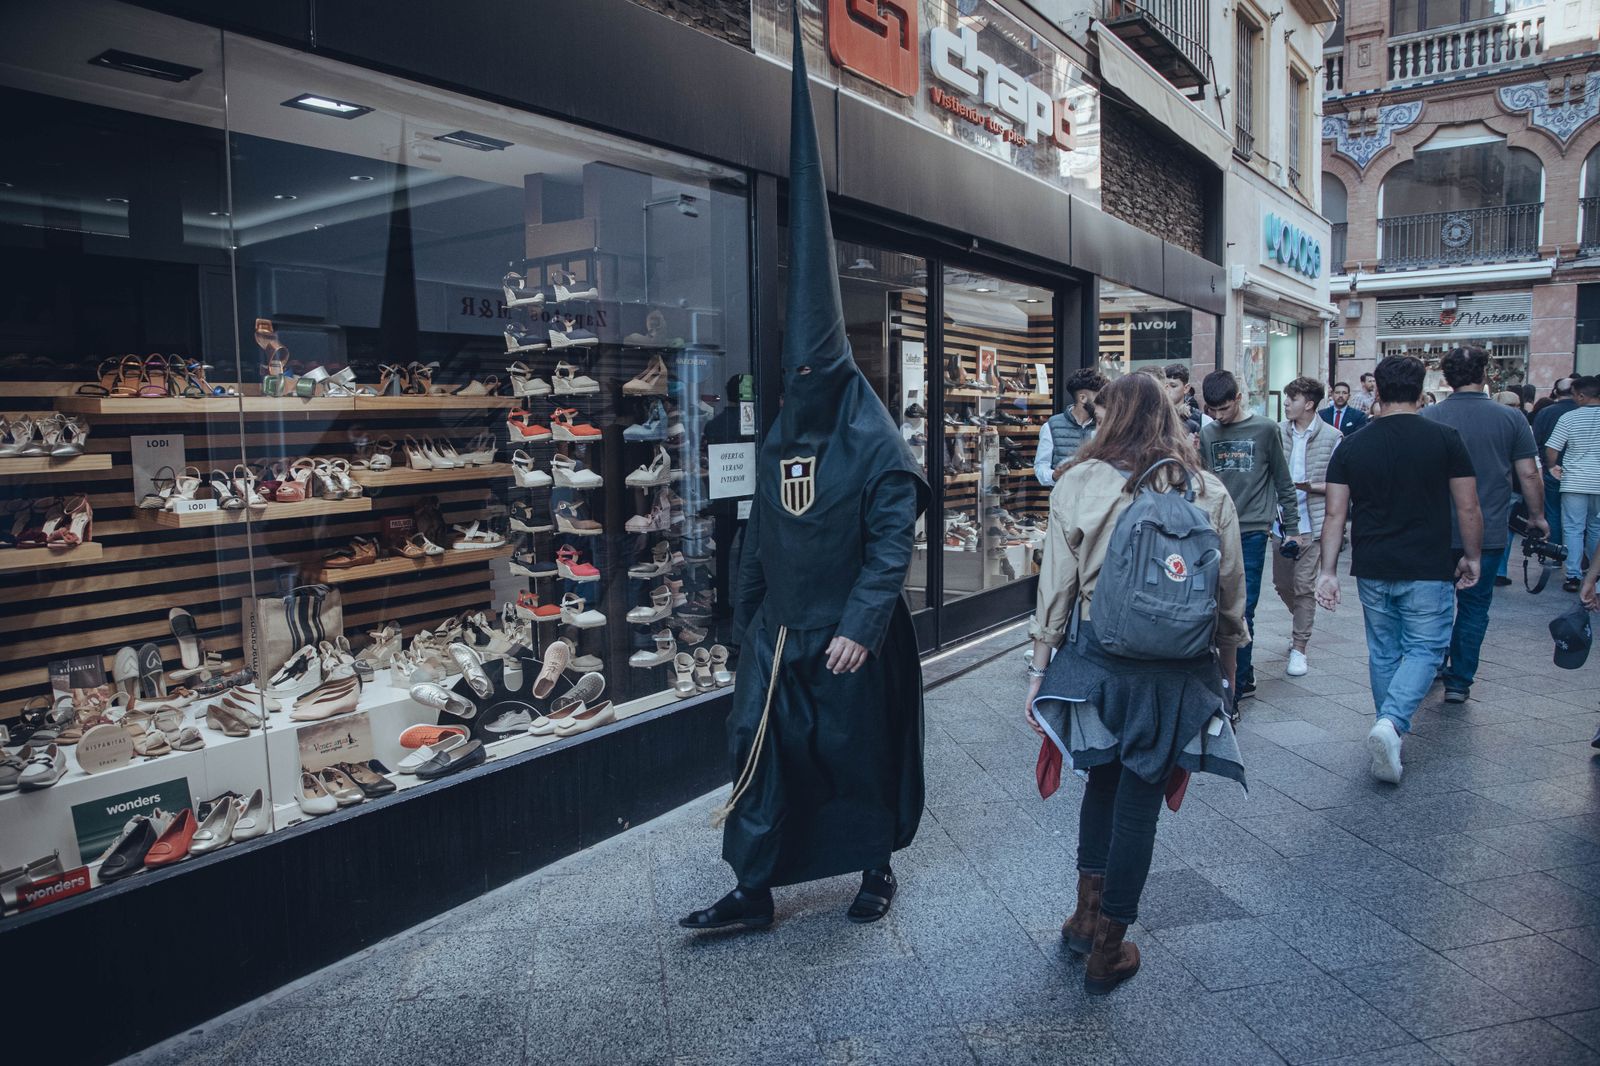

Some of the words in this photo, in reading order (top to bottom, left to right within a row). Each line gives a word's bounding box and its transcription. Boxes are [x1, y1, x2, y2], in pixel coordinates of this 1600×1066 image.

[931, 86, 986, 124] Vistiendo
[986, 115, 1005, 134] tus
[1005, 128, 1027, 146] pies
[1454, 311, 1528, 327] Moreno
[147, 439, 169, 448] LODI
[720, 452, 745, 460] OFERTAS
[722, 463, 744, 472] VERANO
[720, 474, 745, 484] INTERIOR
[188, 503, 207, 511] LODI
[60, 663, 96, 674] HISPANITAS
[86, 738, 127, 751] HISPANITAS
[106, 793, 161, 815] wonders
[25, 876, 85, 902] wonders
